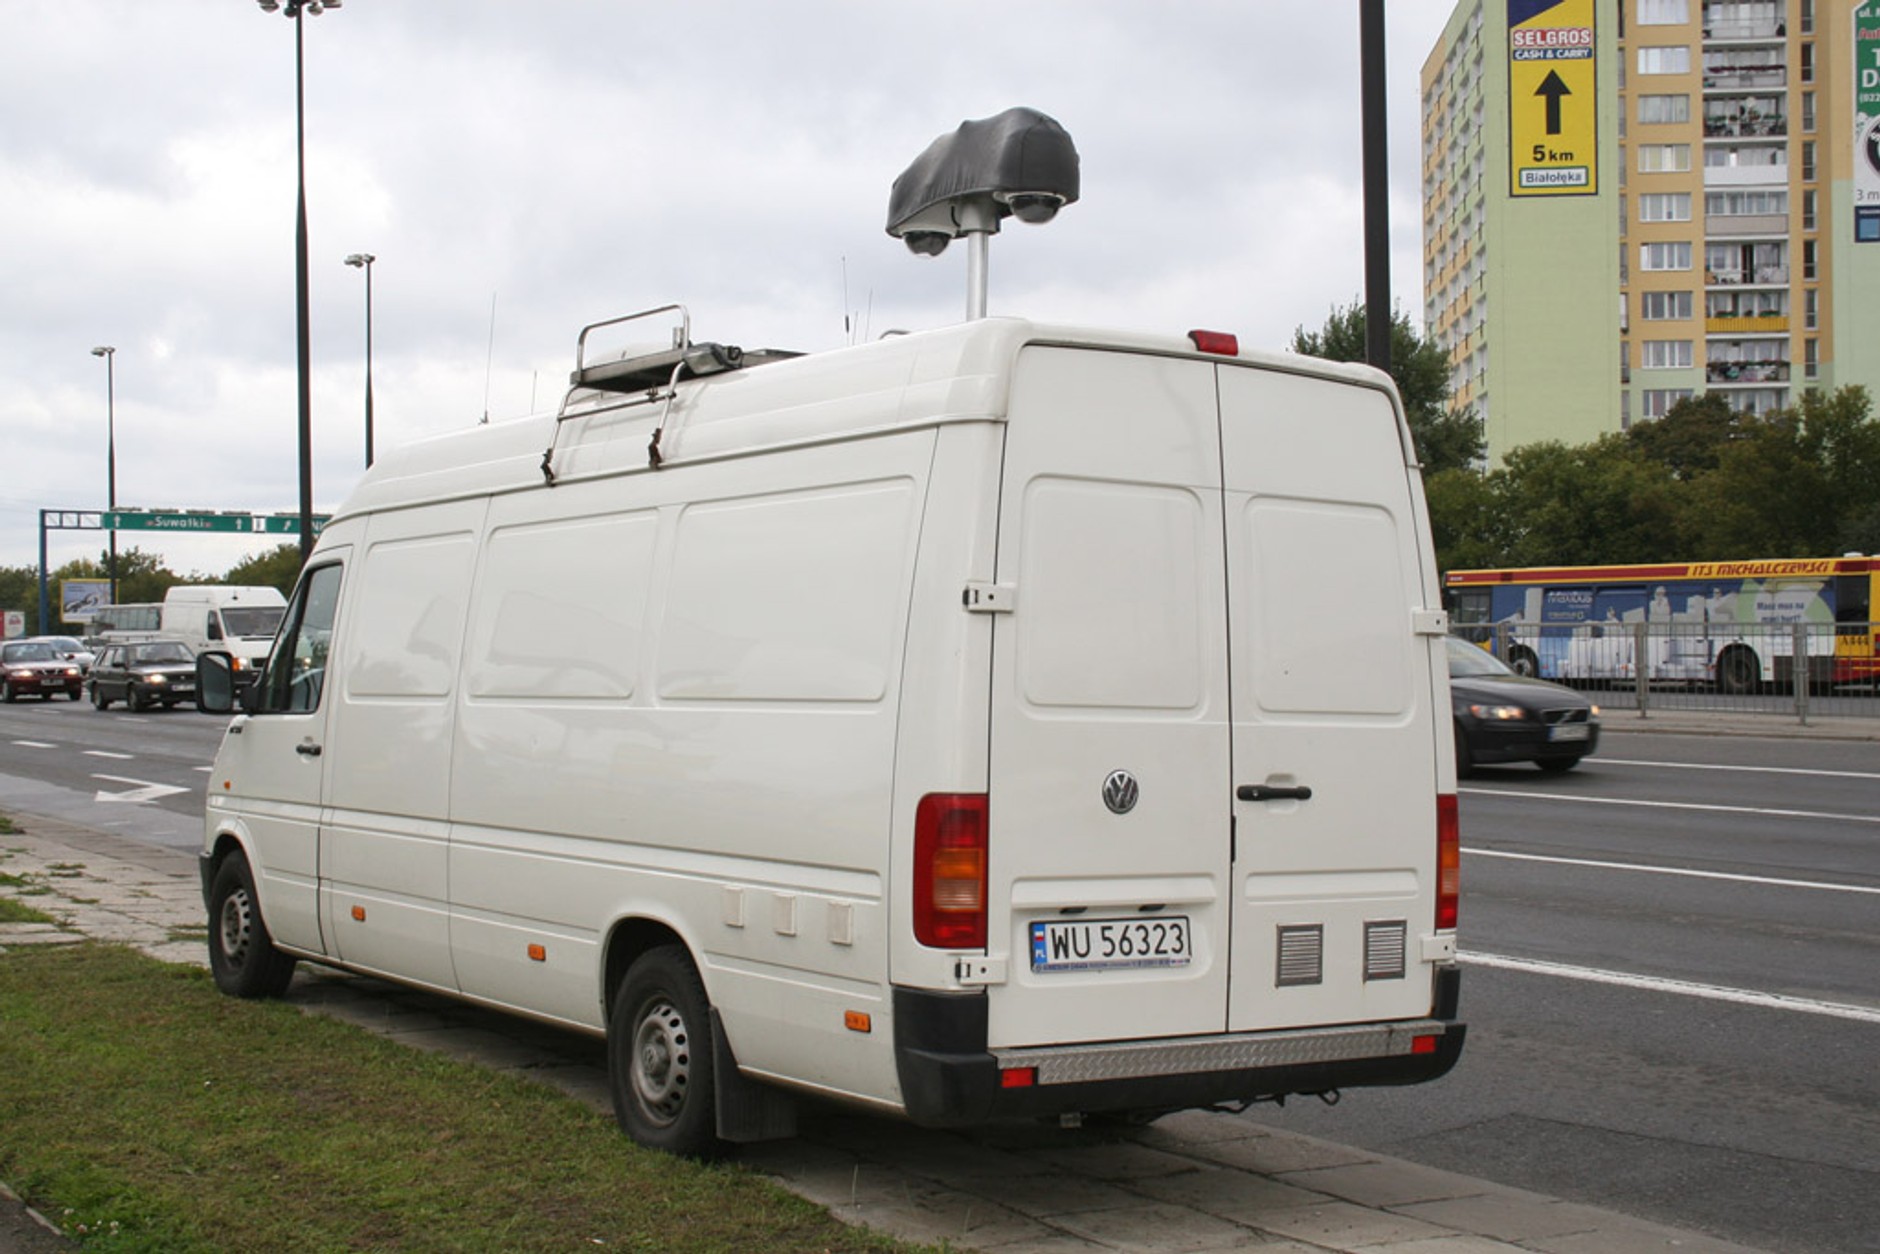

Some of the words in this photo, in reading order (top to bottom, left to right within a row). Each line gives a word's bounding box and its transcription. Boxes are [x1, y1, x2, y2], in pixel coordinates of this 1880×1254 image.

[1514, 30, 1590, 46] SELGROS
[1515, 50, 1543, 59] CASH
[1546, 50, 1554, 58] &
[1556, 49, 1589, 58] CARRY
[1862, 69, 1880, 87] D
[1533, 144, 1545, 162] 5
[1549, 149, 1573, 161] km
[1525, 172, 1582, 184] Białołęka
[155, 516, 204, 528] Suwałki
[1693, 565, 1713, 576] ITS
[1051, 926, 1090, 959] WU
[1101, 923, 1184, 957] 56323
